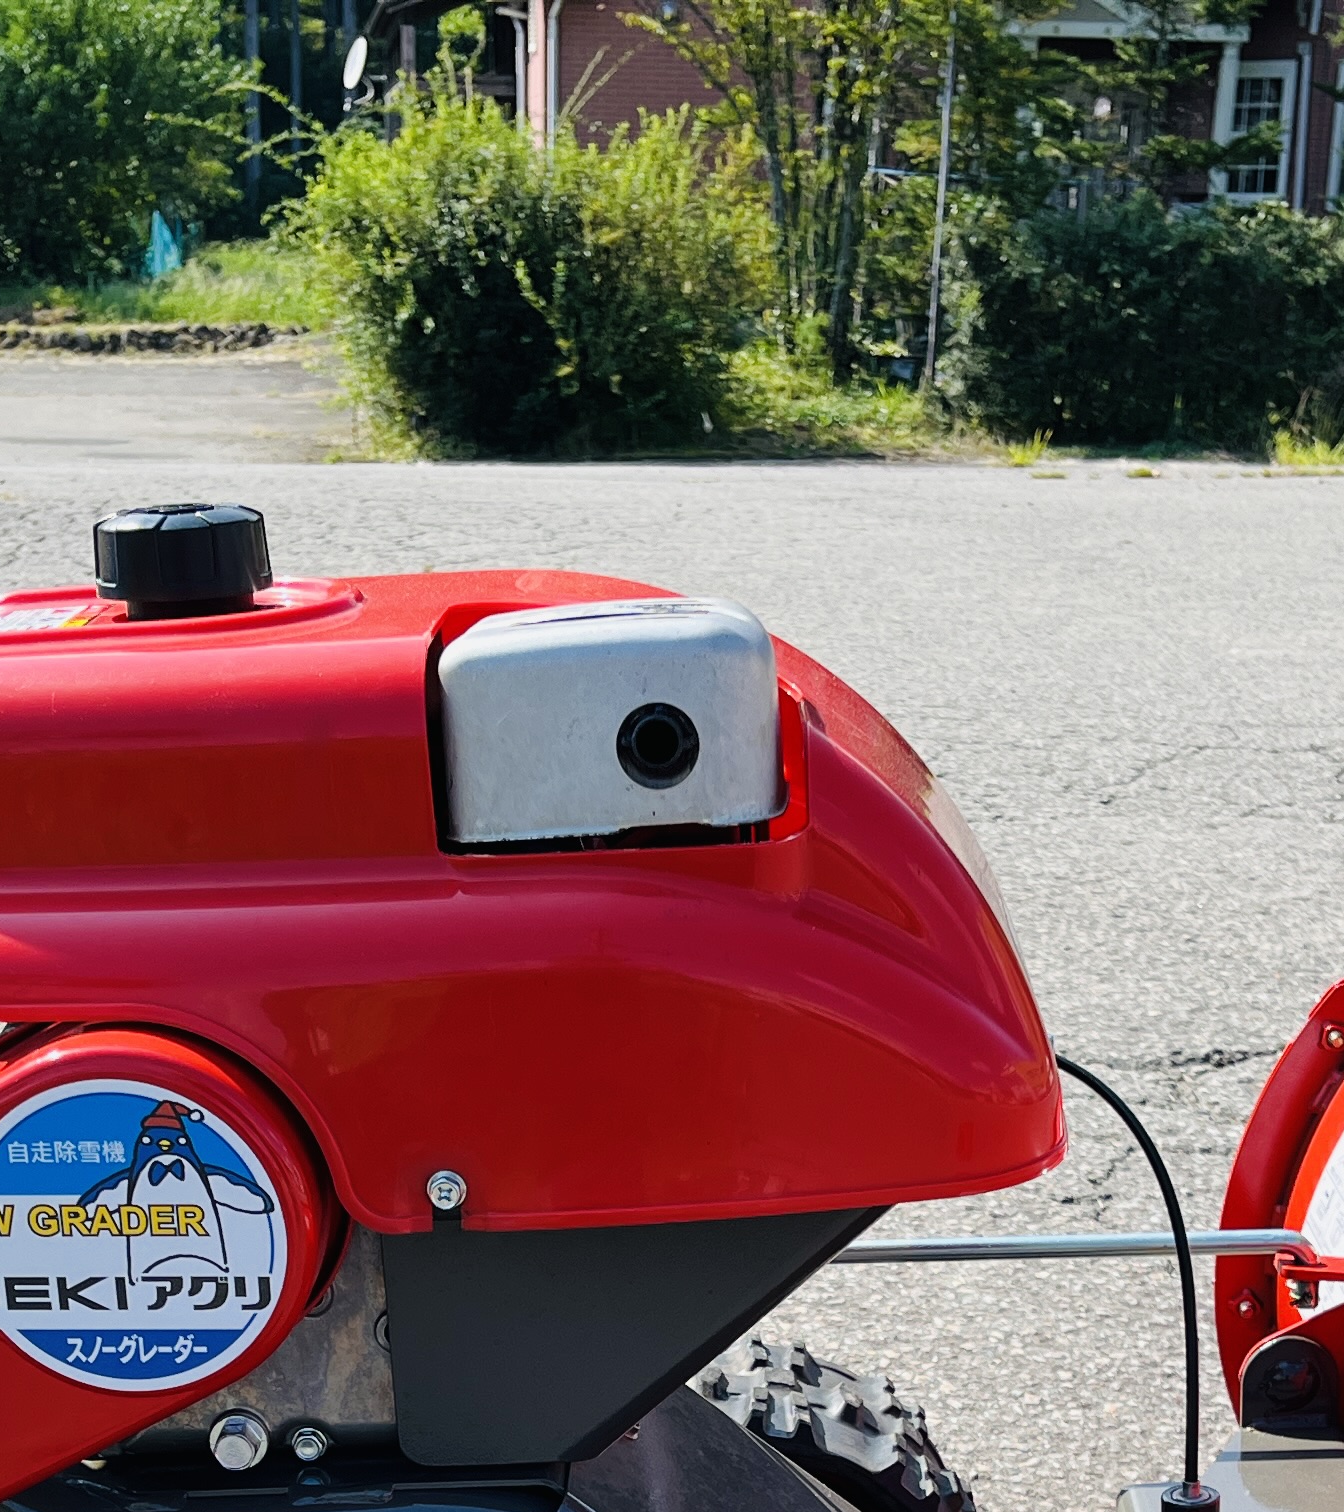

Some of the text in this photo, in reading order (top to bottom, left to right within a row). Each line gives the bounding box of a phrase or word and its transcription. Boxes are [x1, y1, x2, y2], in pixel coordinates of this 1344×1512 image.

[7, 1140, 126, 1165] 自走除雪機
[27, 1204, 210, 1237] GRADER
[65, 1333, 208, 1364] スノーグレーダー
